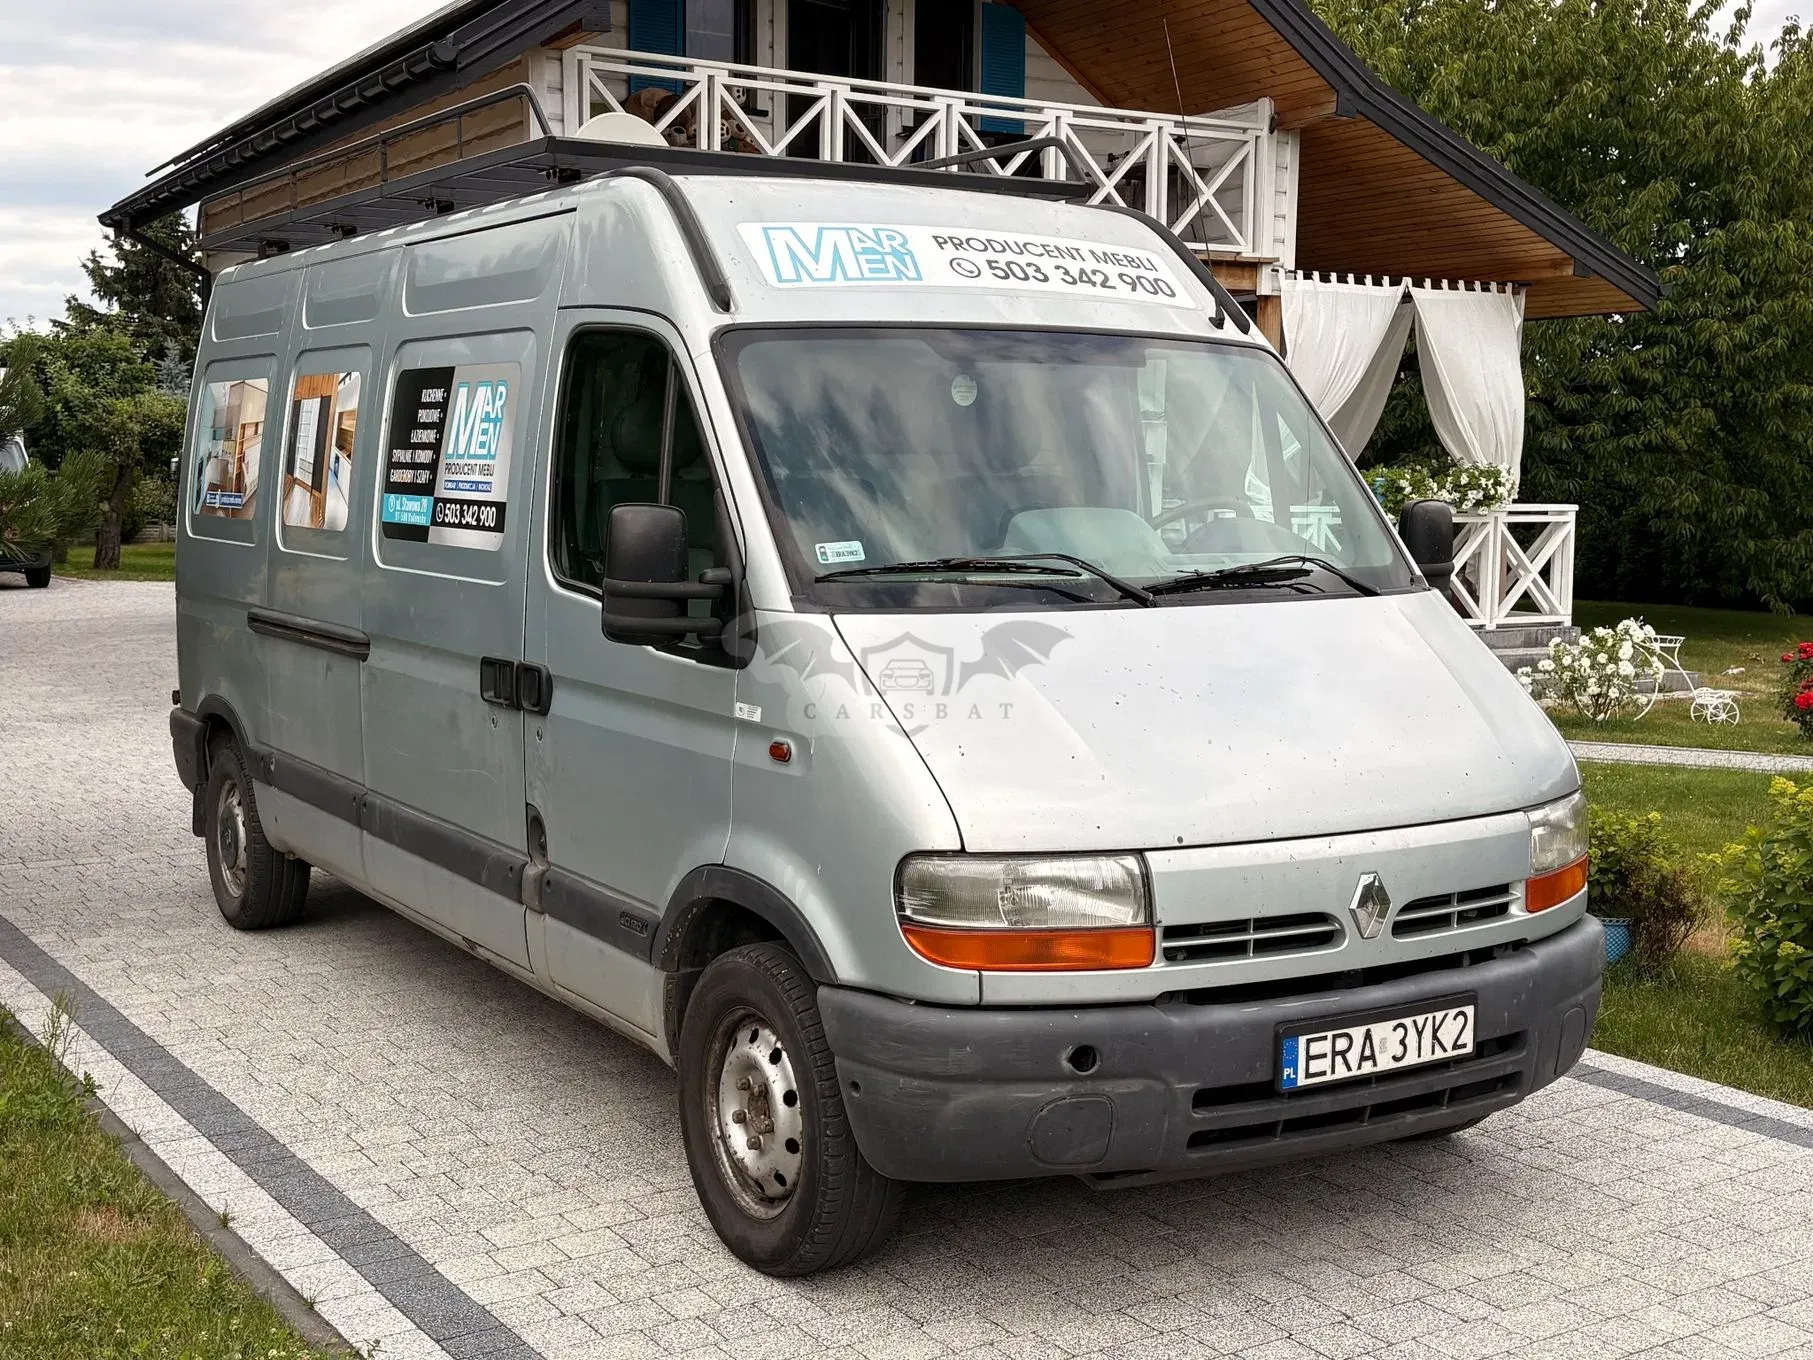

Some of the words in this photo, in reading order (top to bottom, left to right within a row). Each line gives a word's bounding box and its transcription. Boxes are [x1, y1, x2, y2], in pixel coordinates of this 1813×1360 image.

[932, 235, 1087, 262] PRODUCENT
[1088, 249, 1159, 272] MEBLI
[986, 259, 1050, 283] 503
[1054, 265, 1117, 290] 342
[1117, 272, 1177, 298] 900
[444, 462, 478, 476] PRODUCENT
[478, 463, 495, 477] MEBLI
[444, 503, 460, 523] 503
[461, 504, 478, 525] 342
[480, 505, 496, 527] 900
[1304, 1028, 1378, 1079] ERA
[1391, 1010, 1468, 1063] 3YK2
[1283, 1068, 1296, 1080] PL
